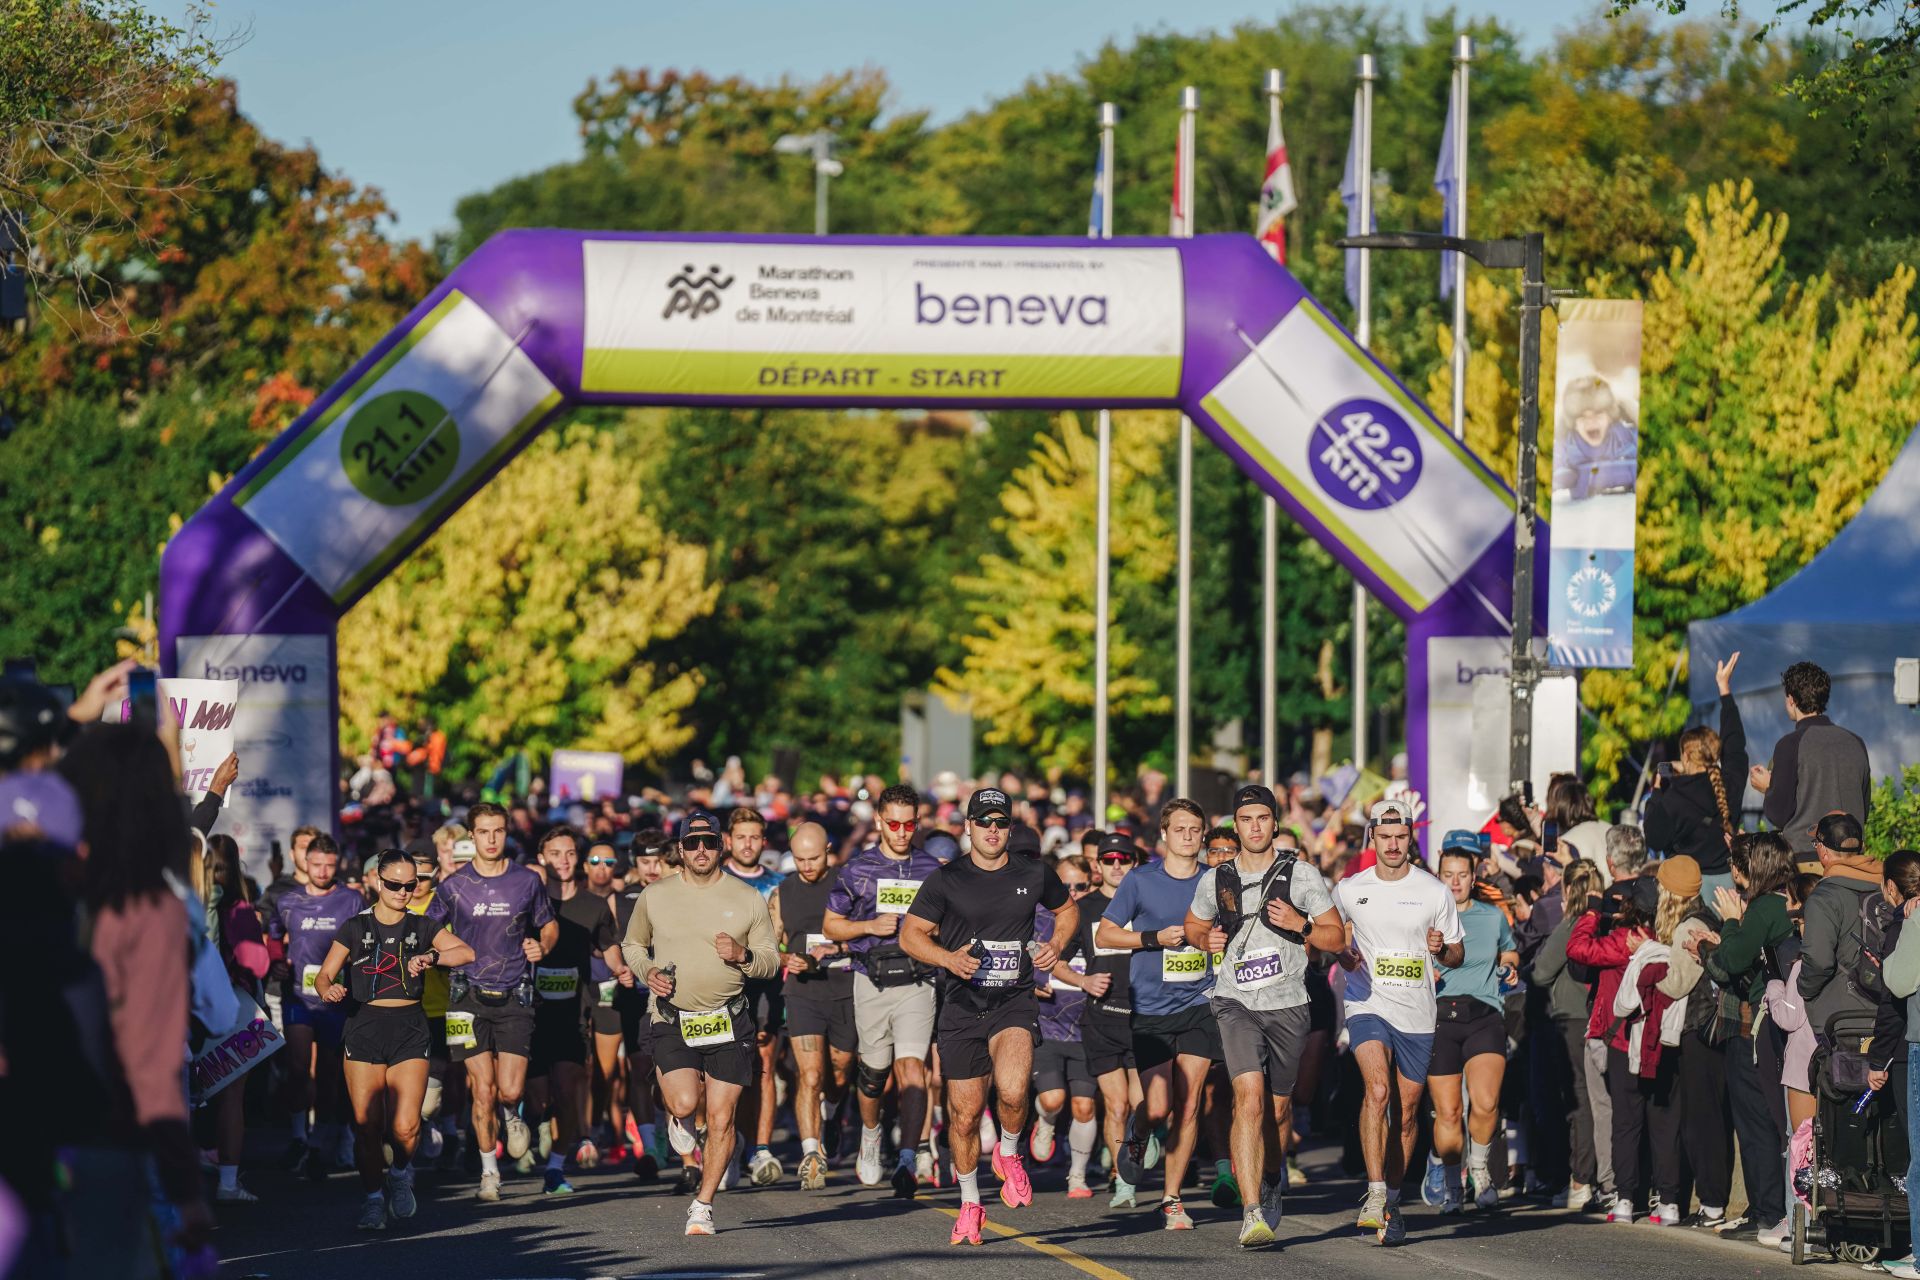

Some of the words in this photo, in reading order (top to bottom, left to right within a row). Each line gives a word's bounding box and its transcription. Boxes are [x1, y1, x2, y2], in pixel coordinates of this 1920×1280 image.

[758, 266, 854, 280] Marathon
[749, 283, 819, 300] Beneva
[915, 281, 1107, 325] beneva
[735, 305, 760, 321] de
[766, 304, 854, 322] Montréal
[759, 361, 880, 386] DÉPART
[909, 368, 1007, 387] START
[353, 402, 425, 475] 21.1
[1341, 411, 1415, 484] 42.2
[382, 437, 446, 491] km
[1320, 433, 1380, 501] km
[205, 659, 307, 683] beneva
[981, 957, 1018, 969] 2676
[1166, 958, 1205, 972] 29324
[1237, 961, 1280, 982] 40347
[1377, 964, 1421, 978] 32583
[540, 980, 575, 991] 22707
[685, 1020, 728, 1037] 29641
